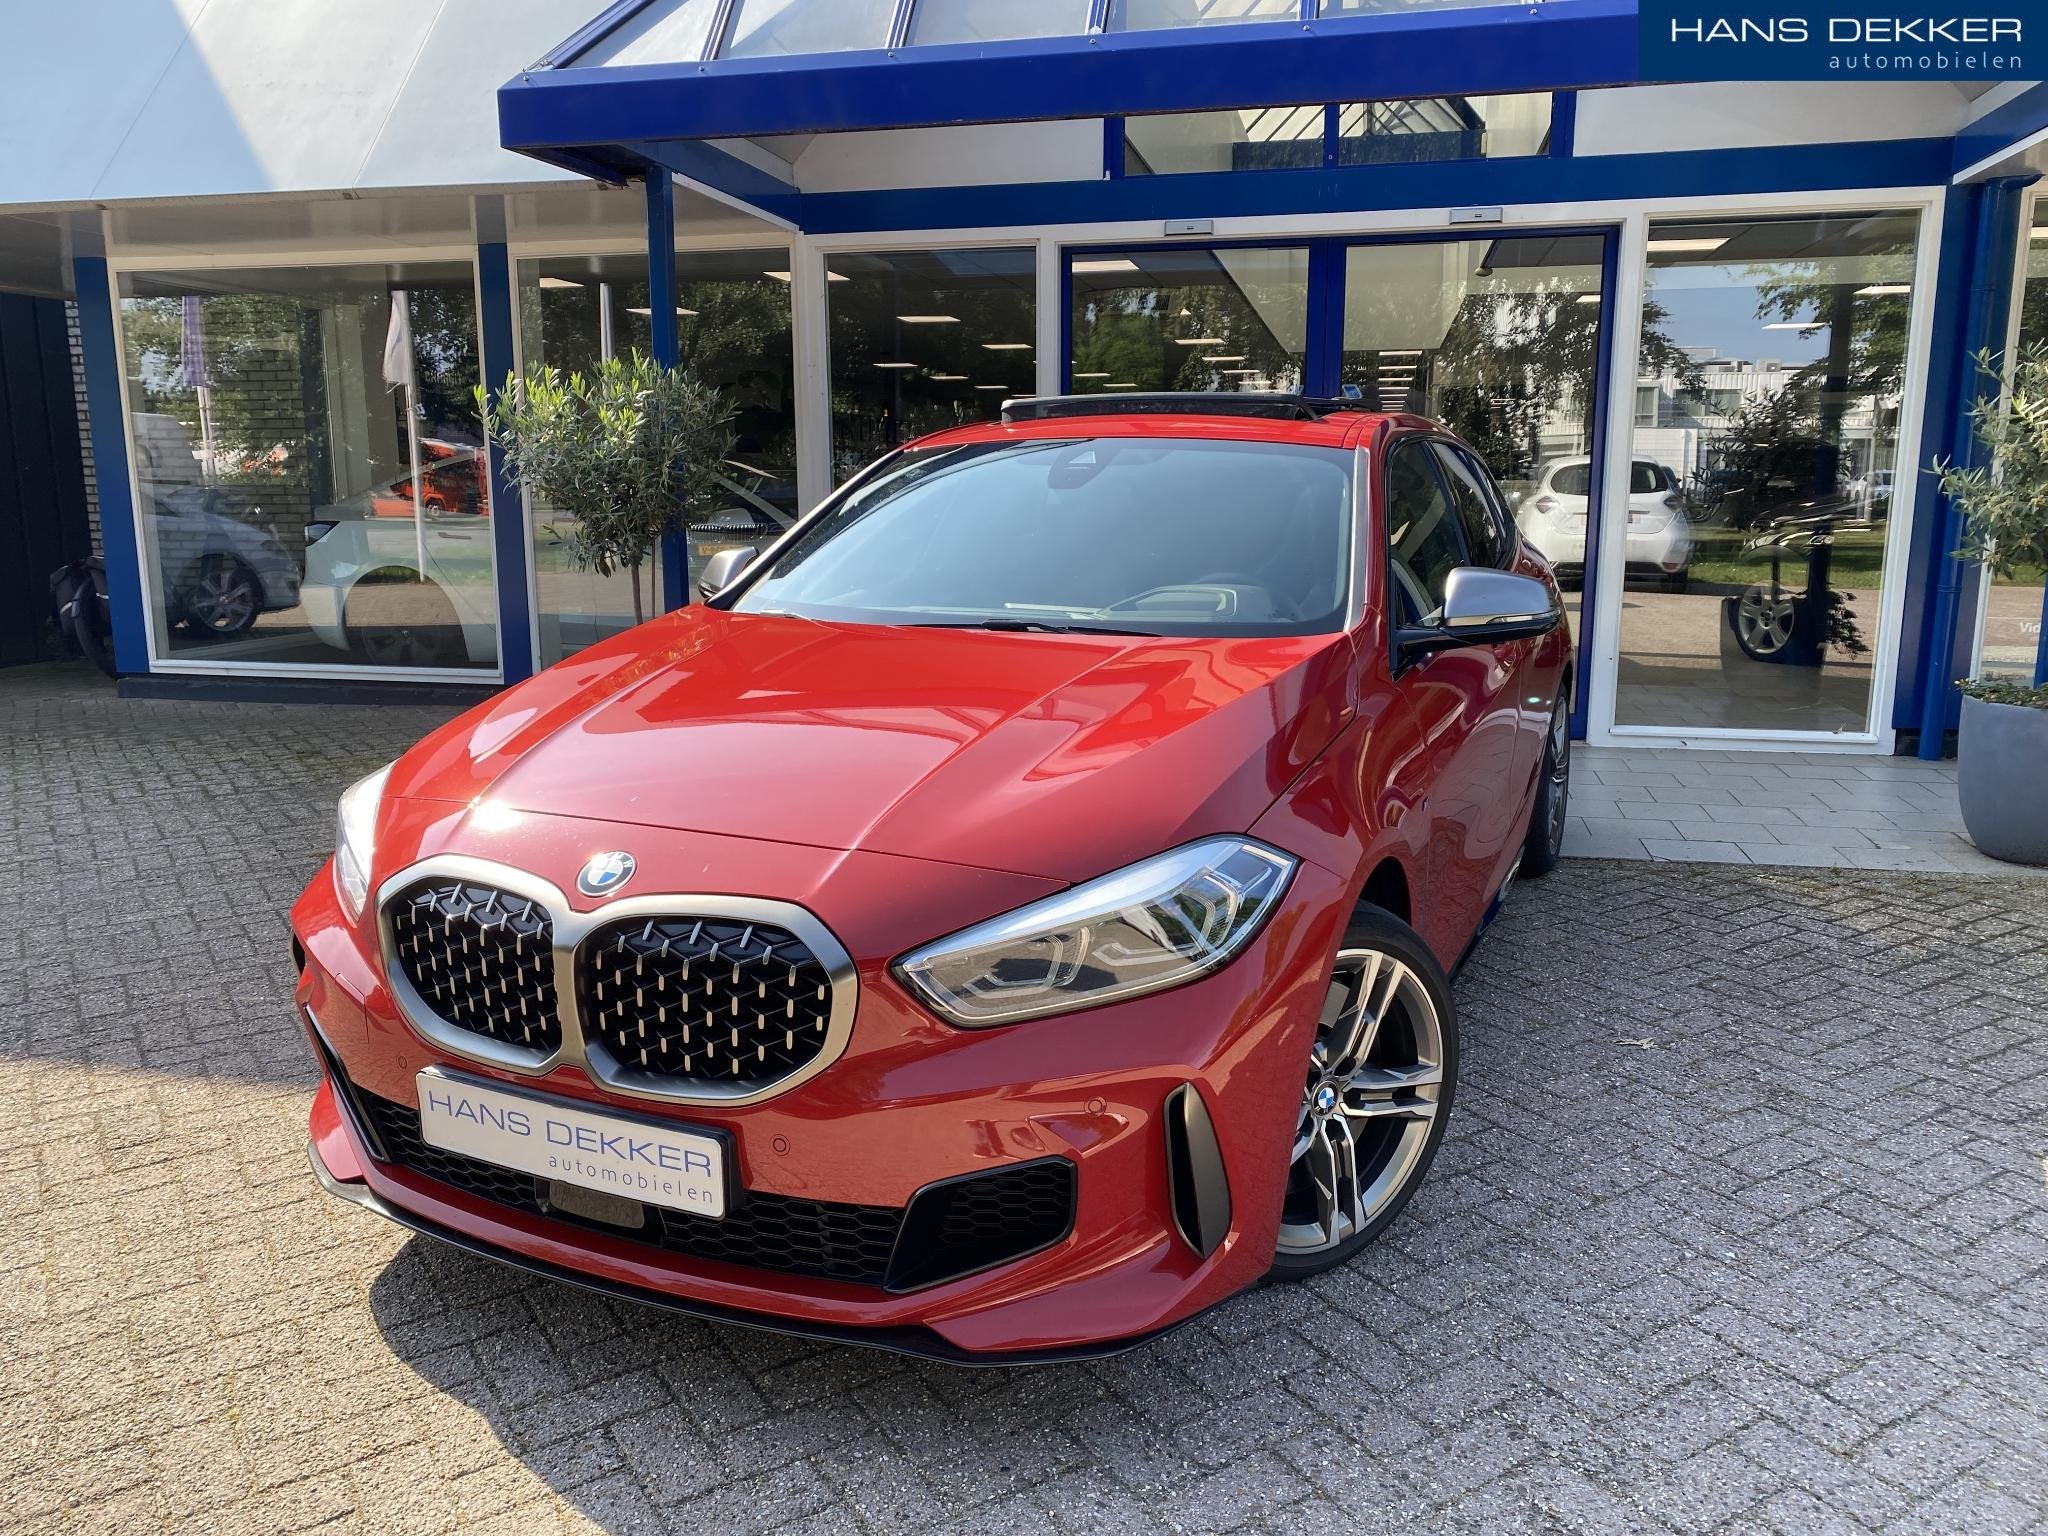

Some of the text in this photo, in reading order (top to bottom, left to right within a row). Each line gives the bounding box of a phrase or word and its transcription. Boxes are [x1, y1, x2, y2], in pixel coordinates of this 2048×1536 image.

[428, 1090, 712, 1178] HANS DEKKER
[548, 1154, 713, 1204] automobielen
